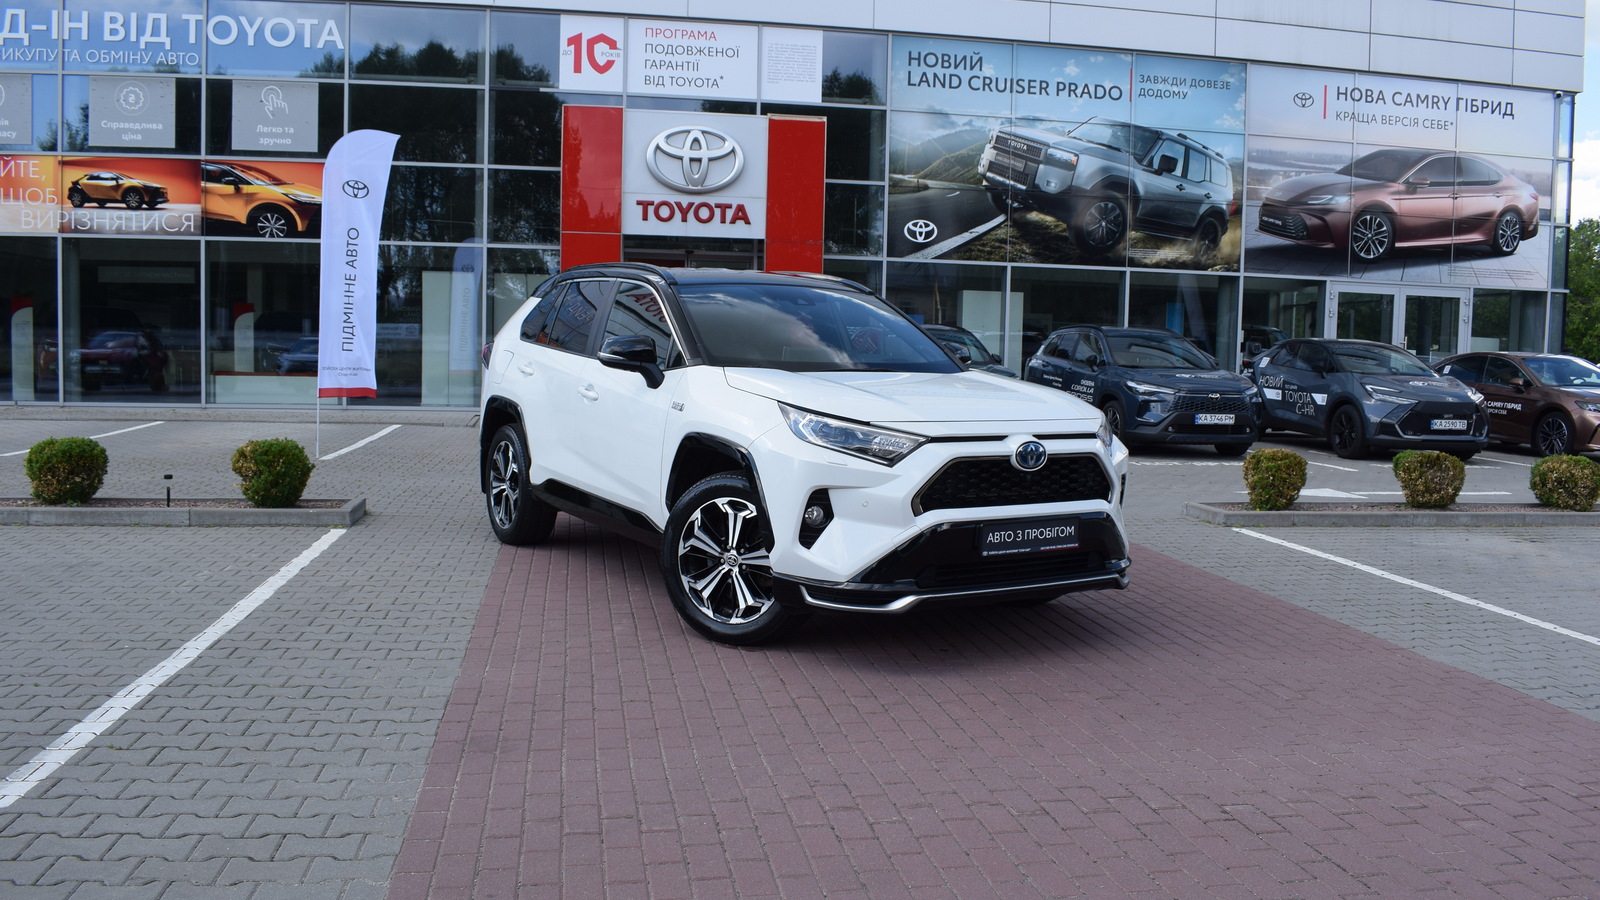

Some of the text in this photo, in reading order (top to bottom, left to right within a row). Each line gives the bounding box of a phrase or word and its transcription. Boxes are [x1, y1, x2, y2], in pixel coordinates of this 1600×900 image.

[103, 12, 171, 50] ВІД
[182, 14, 345, 49] TOYOTA
[645, 27, 717, 41] ПРОГРАМА
[1, 48, 199, 66] ИКУПУ ТА ОБМІНУ АВТО
[644, 43, 741, 59] ПОДОВЖЕНОЇ
[644, 59, 700, 72] ГАРАНТІЇ
[907, 51, 983, 71] НОВИЙ
[644, 75, 665, 88] ВІД
[907, 71, 1123, 101] LAND CRUISER PRADO
[1138, 74, 1231, 90] ЗАВЖДИ ДОВЕЗЕ
[1138, 88, 1188, 100] ДОДОМУ
[1336, 86, 1515, 120] НОВА CAMRY ГІБРИД
[101, 120, 163, 131] Справедлива
[1335, 111, 1378, 125] КРАЩА
[1381, 115, 1419, 128] ВЕРСІЯ
[122, 131, 142, 141] ціна
[256, 125, 282, 134] Легко
[259, 137, 292, 146] зручно
[1008, 140, 1027, 150] TOYOTA
[636, 200, 751, 225] TOYOTA
[21, 209, 195, 232] ВИРІЗНЯТИСЯ
[342, 227, 360, 352] ПІДМІННЕ АВТО
[1258, 376, 1284, 388] НОВИЙ
[1284, 390, 1312, 404] TOYOTA
[1295, 403, 1316, 416] C-HR
[986, 531, 1014, 544] АВТО
[1024, 526, 1075, 541] ПРОБІГОМ
